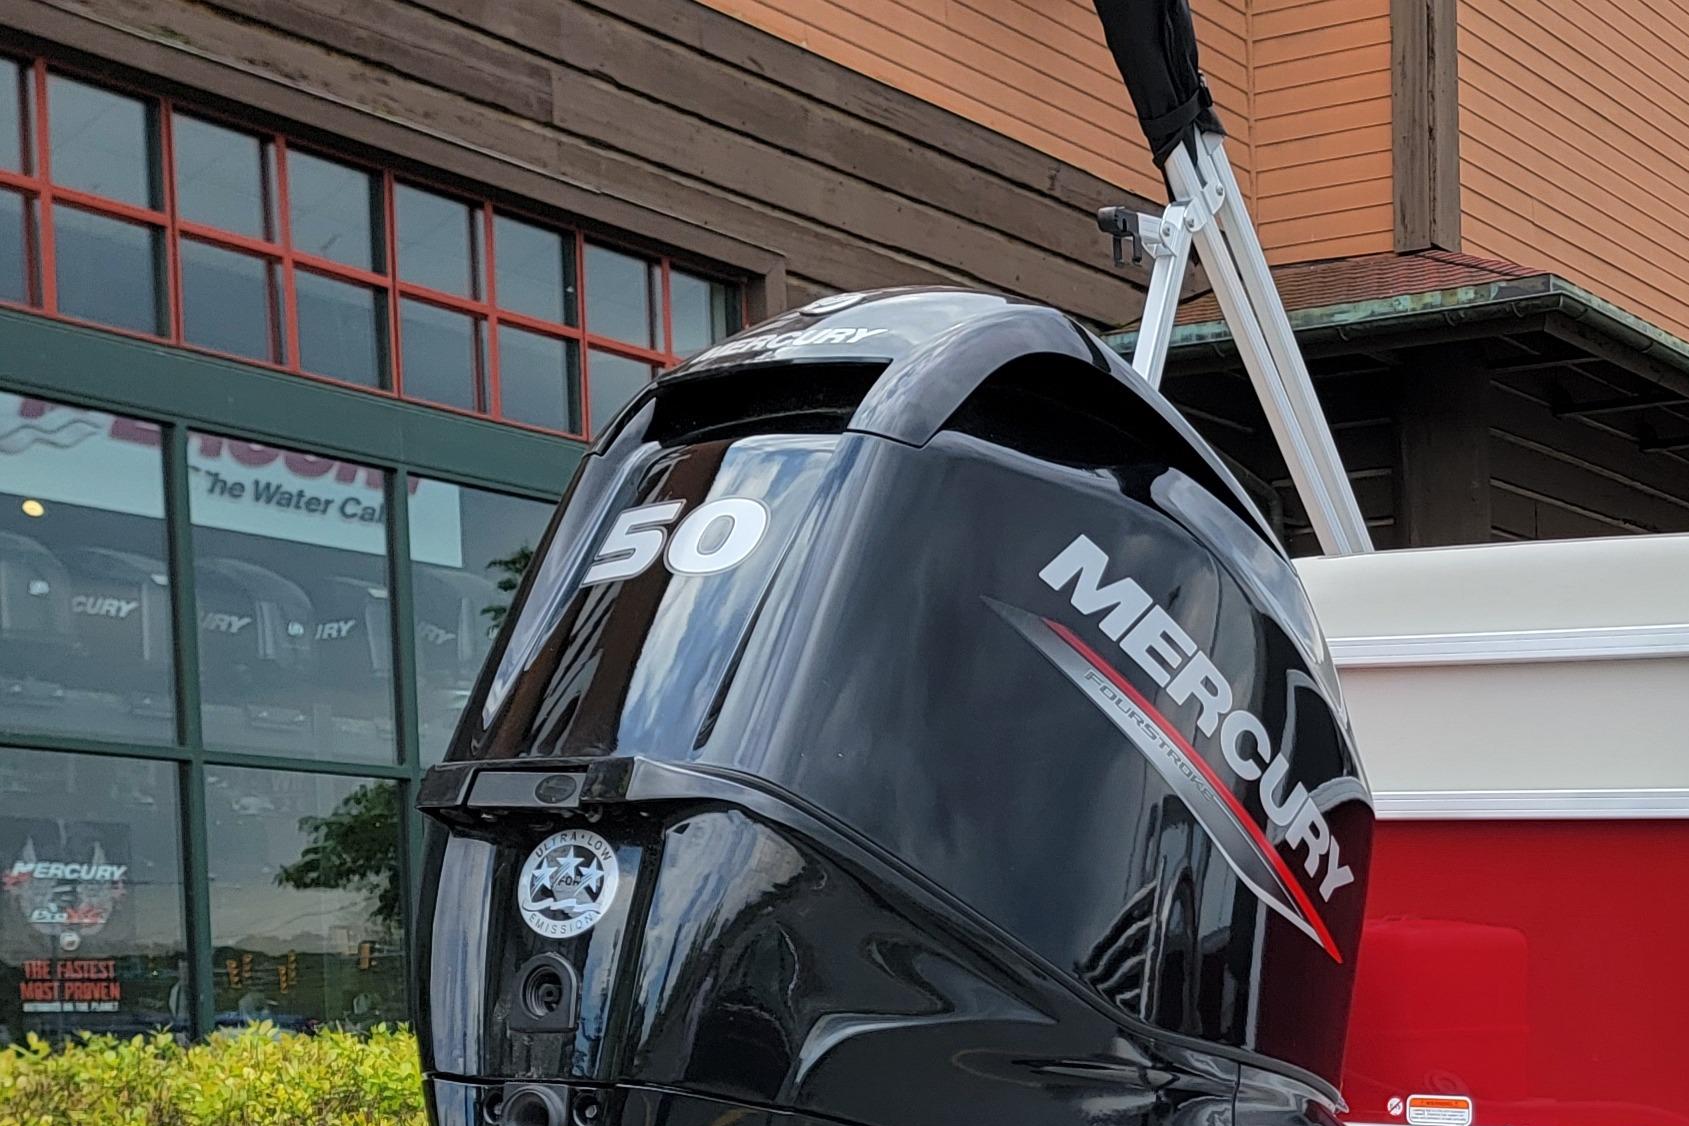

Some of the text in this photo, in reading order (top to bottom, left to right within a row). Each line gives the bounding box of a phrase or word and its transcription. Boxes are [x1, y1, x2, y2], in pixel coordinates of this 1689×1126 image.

[690, 328, 889, 365] MERCURY
[253, 478, 335, 516] Water
[580, 497, 771, 588] 50
[1038, 534, 1354, 902] MERCURY
[1084, 668, 1217, 802] FOURSTROKE
[535, 831, 613, 861] ULTRA LOW
[11, 861, 128, 881] MERCURY
[529, 912, 594, 934] EMISSION
[24, 960, 116, 979] THE FASTEST
[20, 981, 120, 1001] MOST PROVEN
